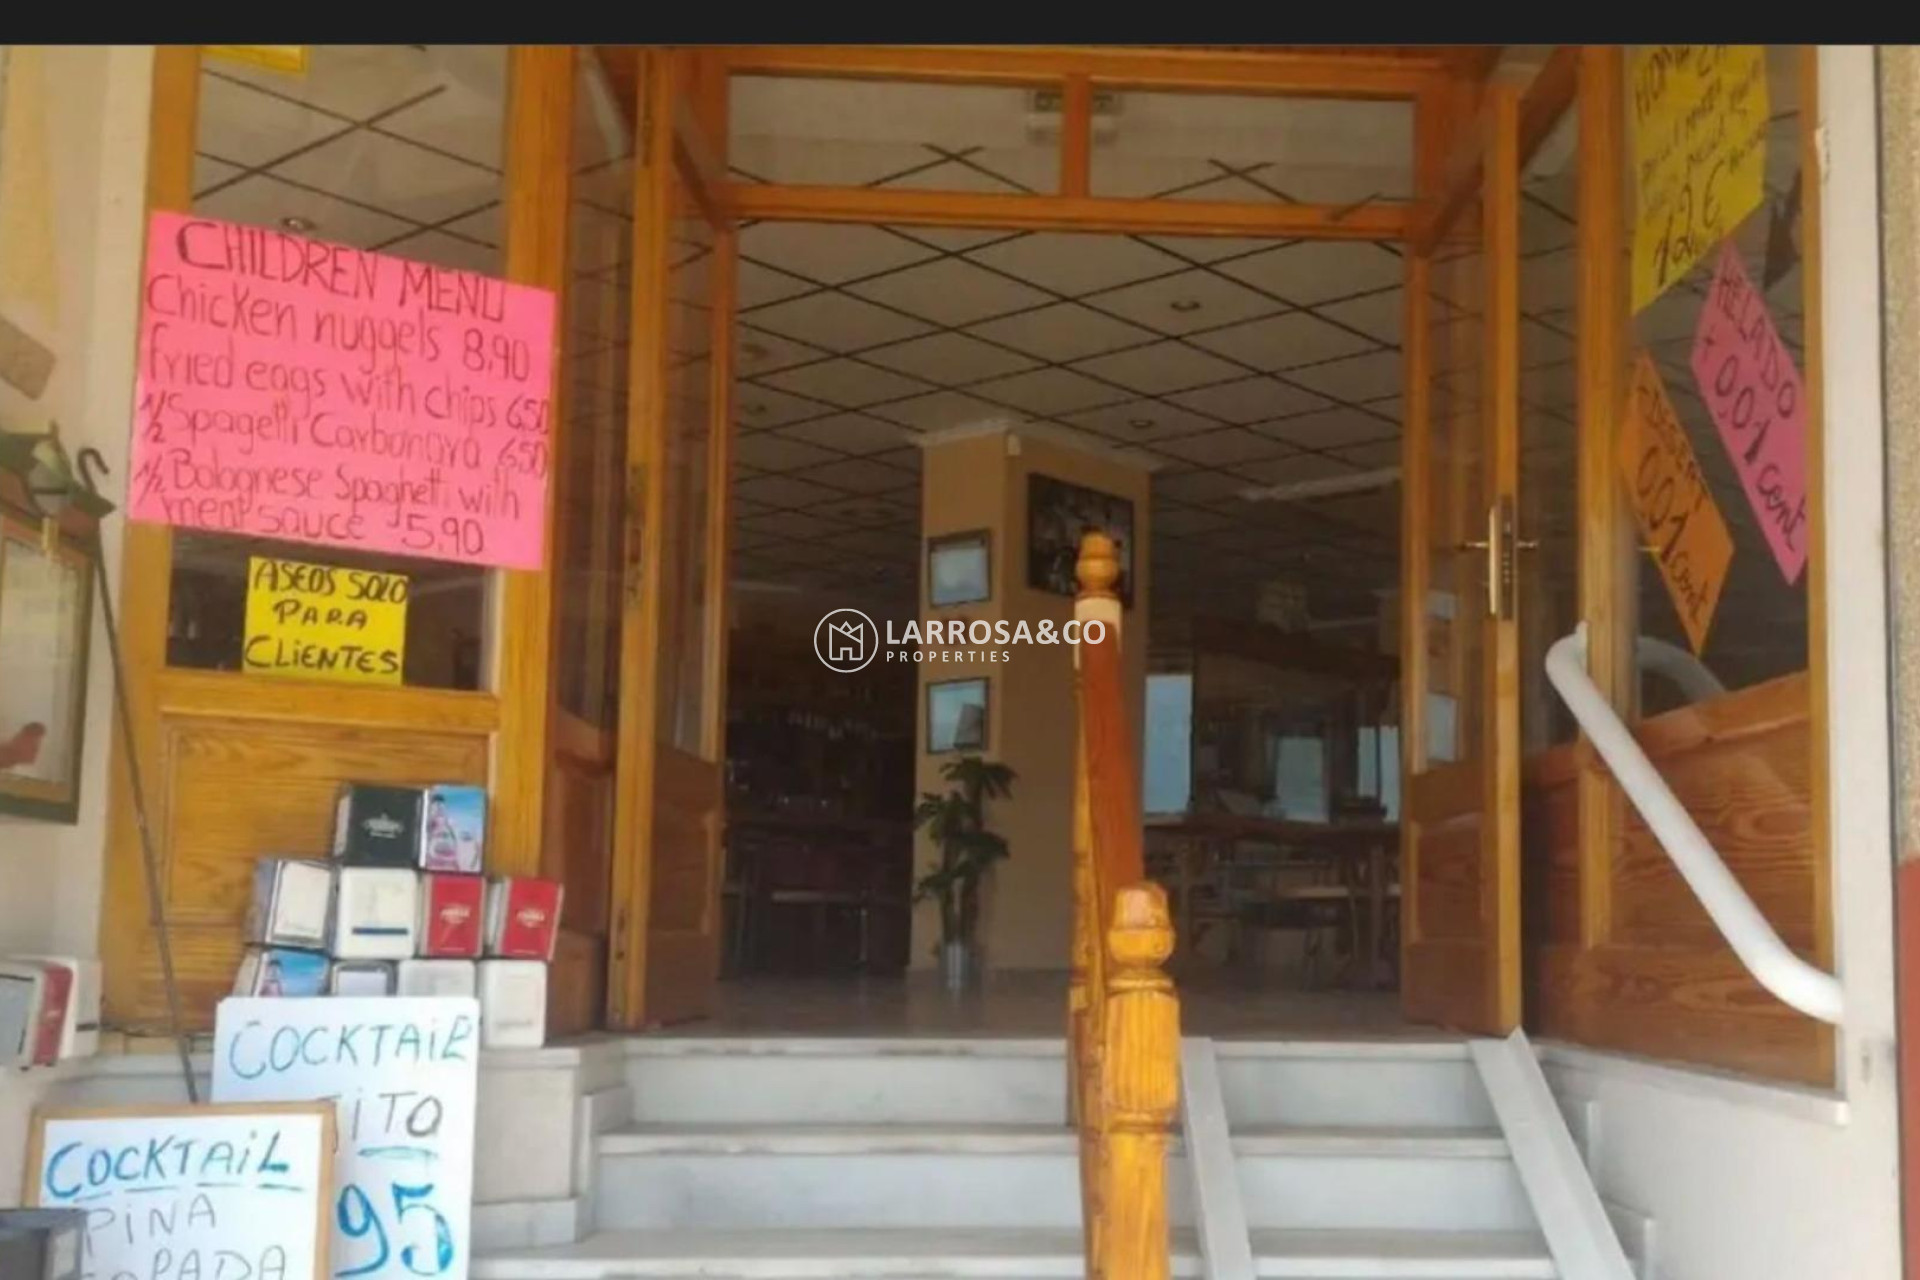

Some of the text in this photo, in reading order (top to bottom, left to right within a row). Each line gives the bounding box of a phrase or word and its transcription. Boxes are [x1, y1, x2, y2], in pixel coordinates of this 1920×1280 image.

[177, 220, 504, 322] CHILDREN MENU
[147, 273, 297, 342] Chicken
[340, 365, 416, 419] with
[256, 504, 365, 541] sauce
[253, 560, 409, 605] ASEOS SOLO
[272, 598, 369, 631] PARA
[320, 1088, 444, 1142] iTO
